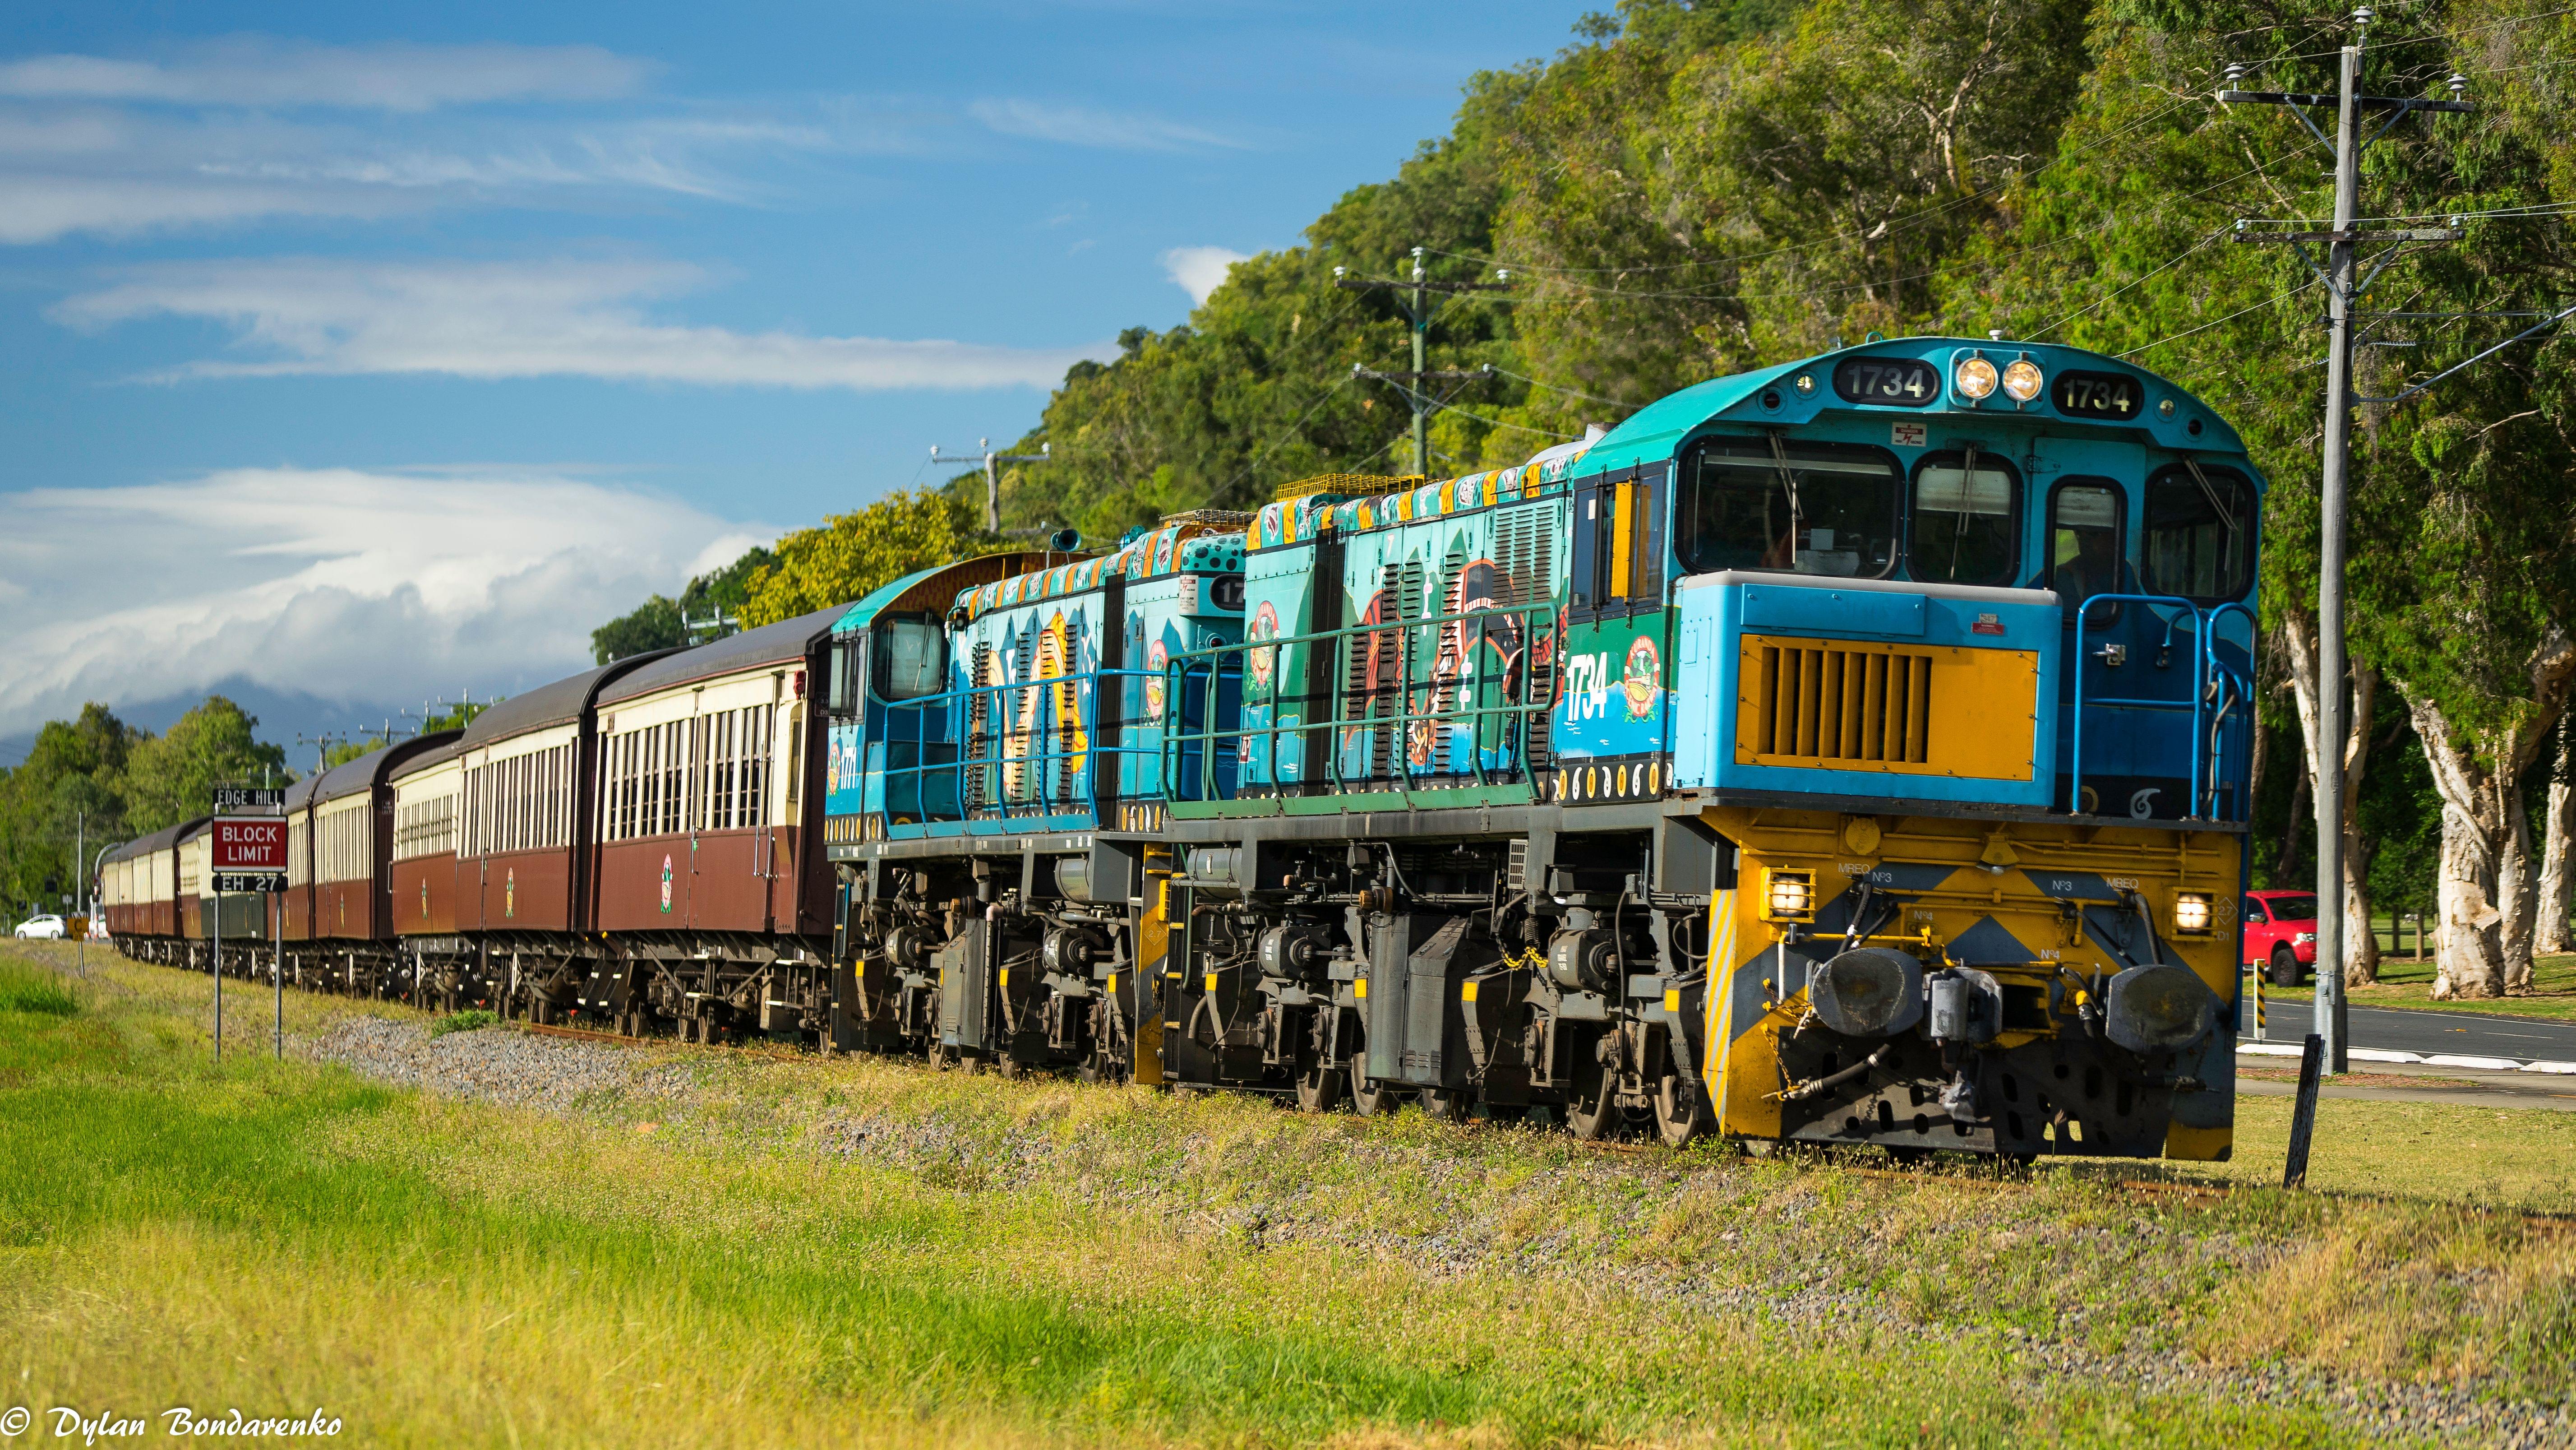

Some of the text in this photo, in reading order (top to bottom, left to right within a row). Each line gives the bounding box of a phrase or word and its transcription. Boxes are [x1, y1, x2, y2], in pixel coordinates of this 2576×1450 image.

[1847, 365, 1925, 398] 1734
[2063, 379, 2131, 412] 1734
[1566, 652, 1608, 722] 1734
[840, 746, 857, 790] 1771
[218, 790, 281, 805] EDGE HILL
[222, 826, 277, 843] BLOCK
[228, 846, 272, 862] LIMIT
[222, 876, 277, 891] EH 27
